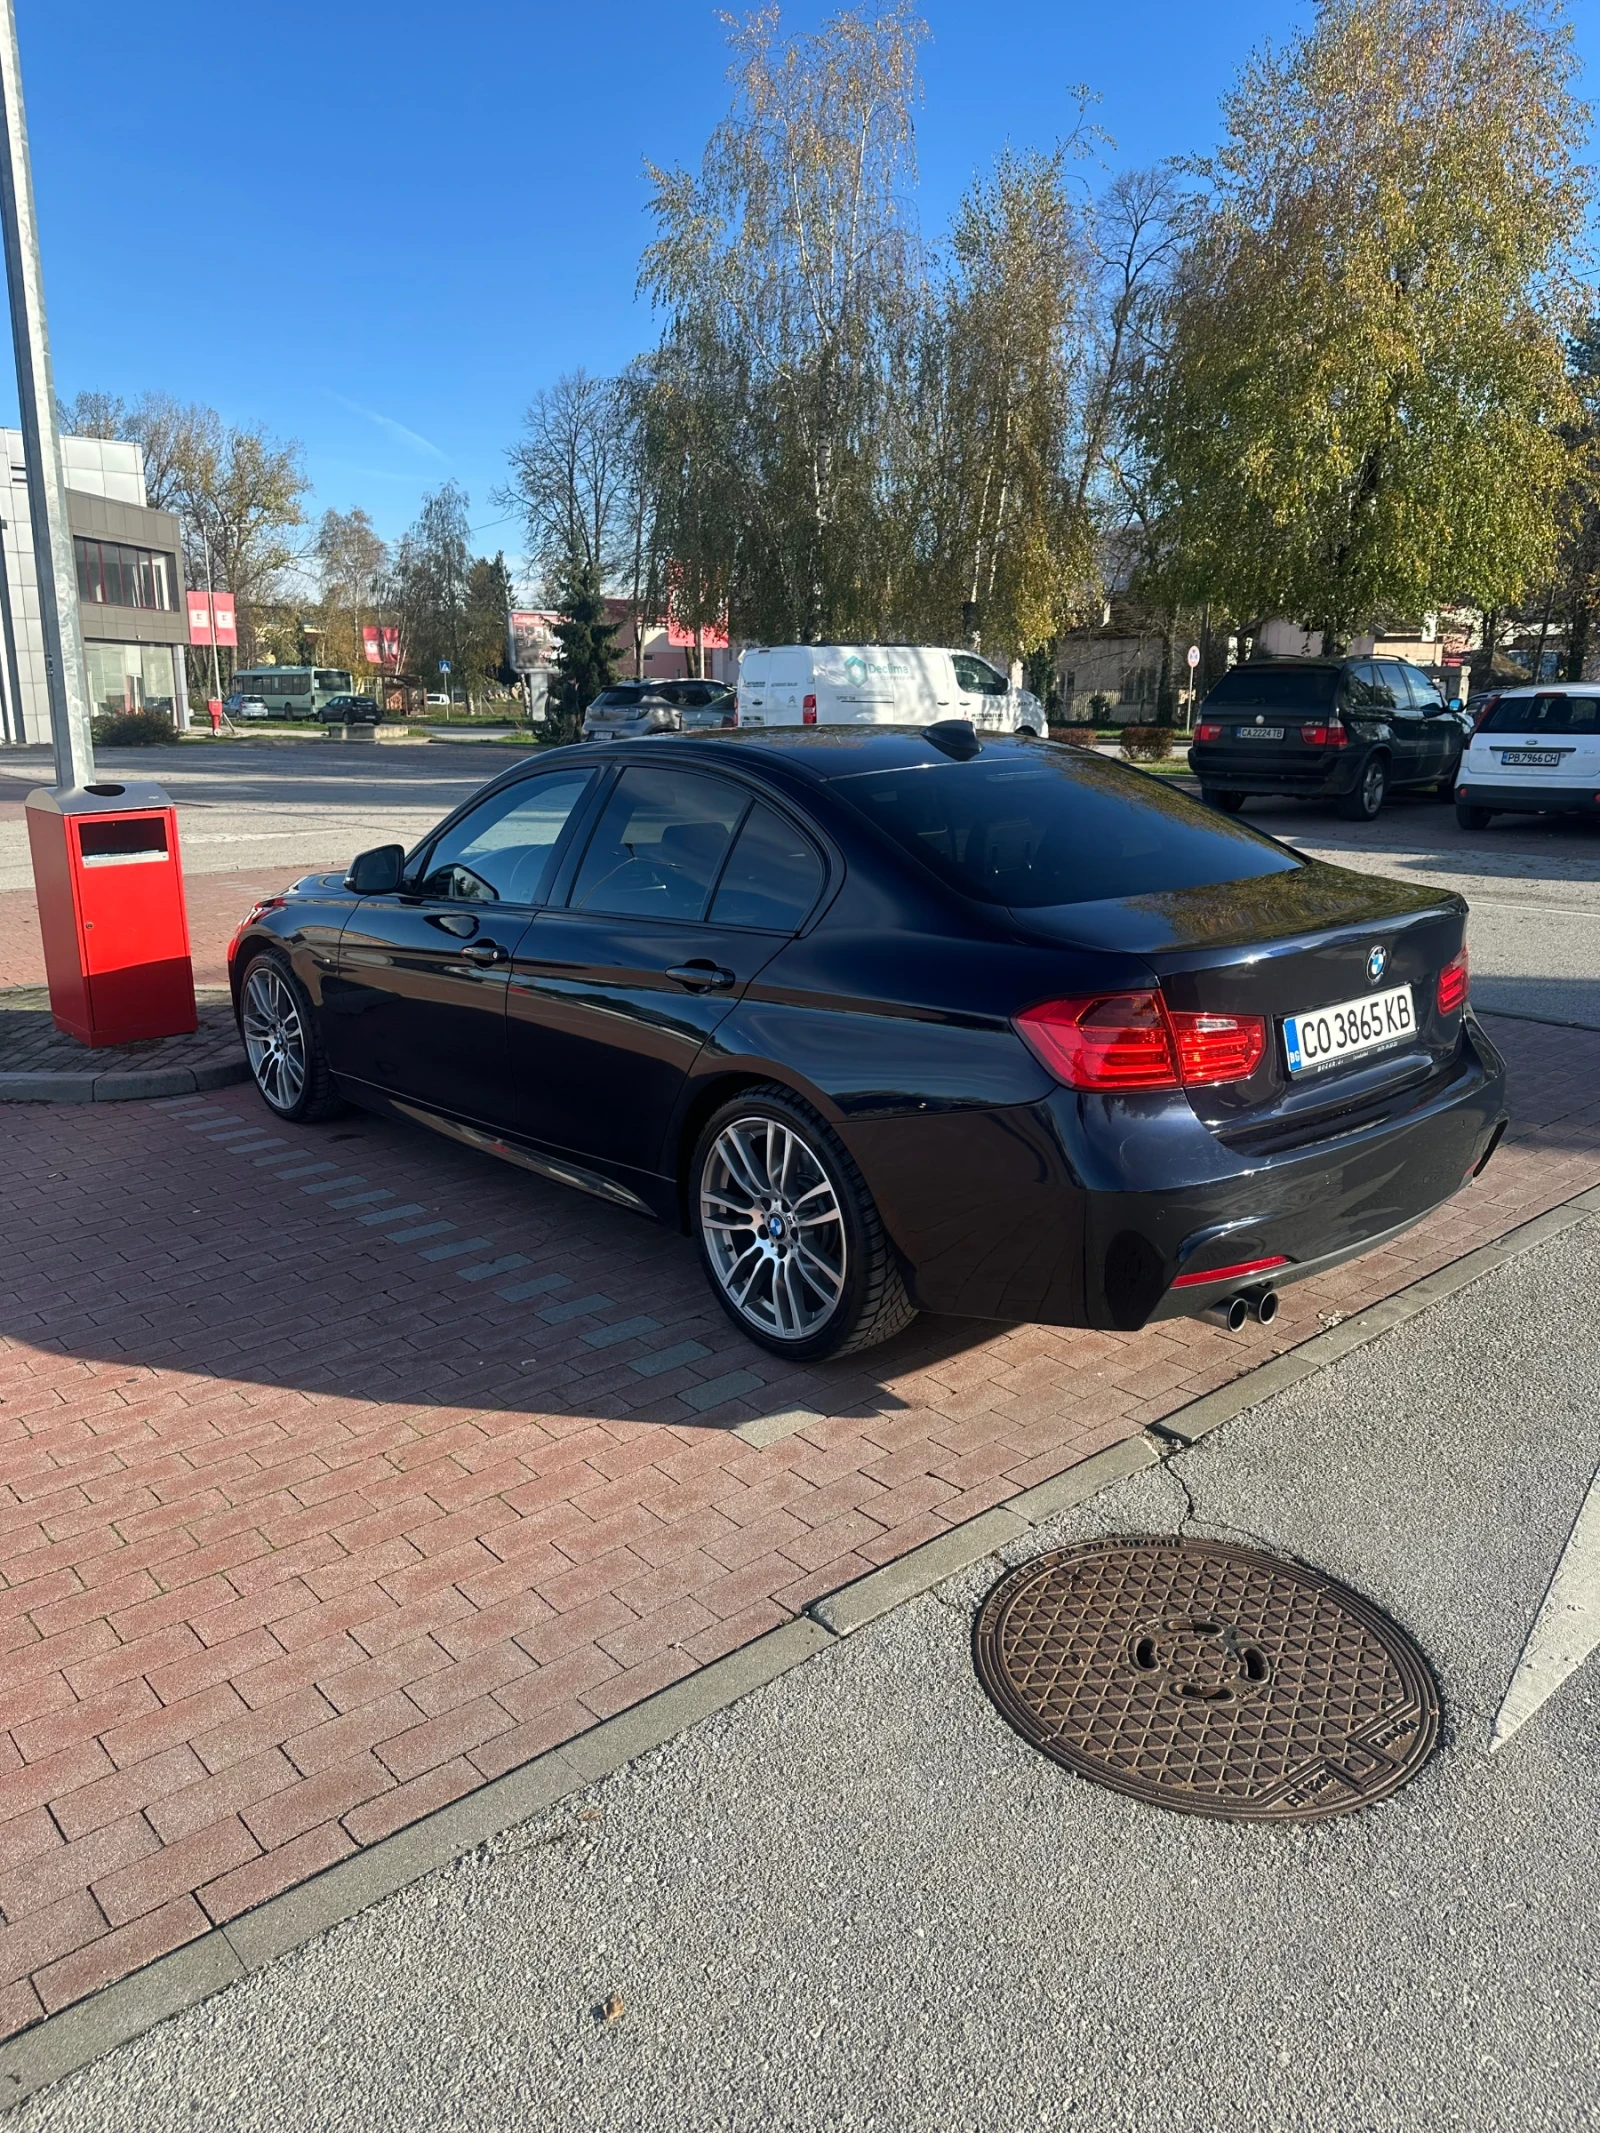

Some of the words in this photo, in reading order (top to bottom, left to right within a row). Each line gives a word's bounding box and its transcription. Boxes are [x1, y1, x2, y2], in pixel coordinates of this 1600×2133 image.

[868, 662, 909, 674] Declima
[1242, 729, 1252, 737] CA
[1253, 729, 1271, 738] 2224
[1272, 729, 1282, 738] TB
[1508, 753, 1520, 762] PB
[1520, 753, 1543, 763] 7966
[1543, 754, 1557, 763] CH
[1302, 1017, 1331, 1058] CO
[1334, 1001, 1383, 1048] 3865
[1385, 994, 1410, 1033] KB
[1289, 1051, 1300, 1064] BG
